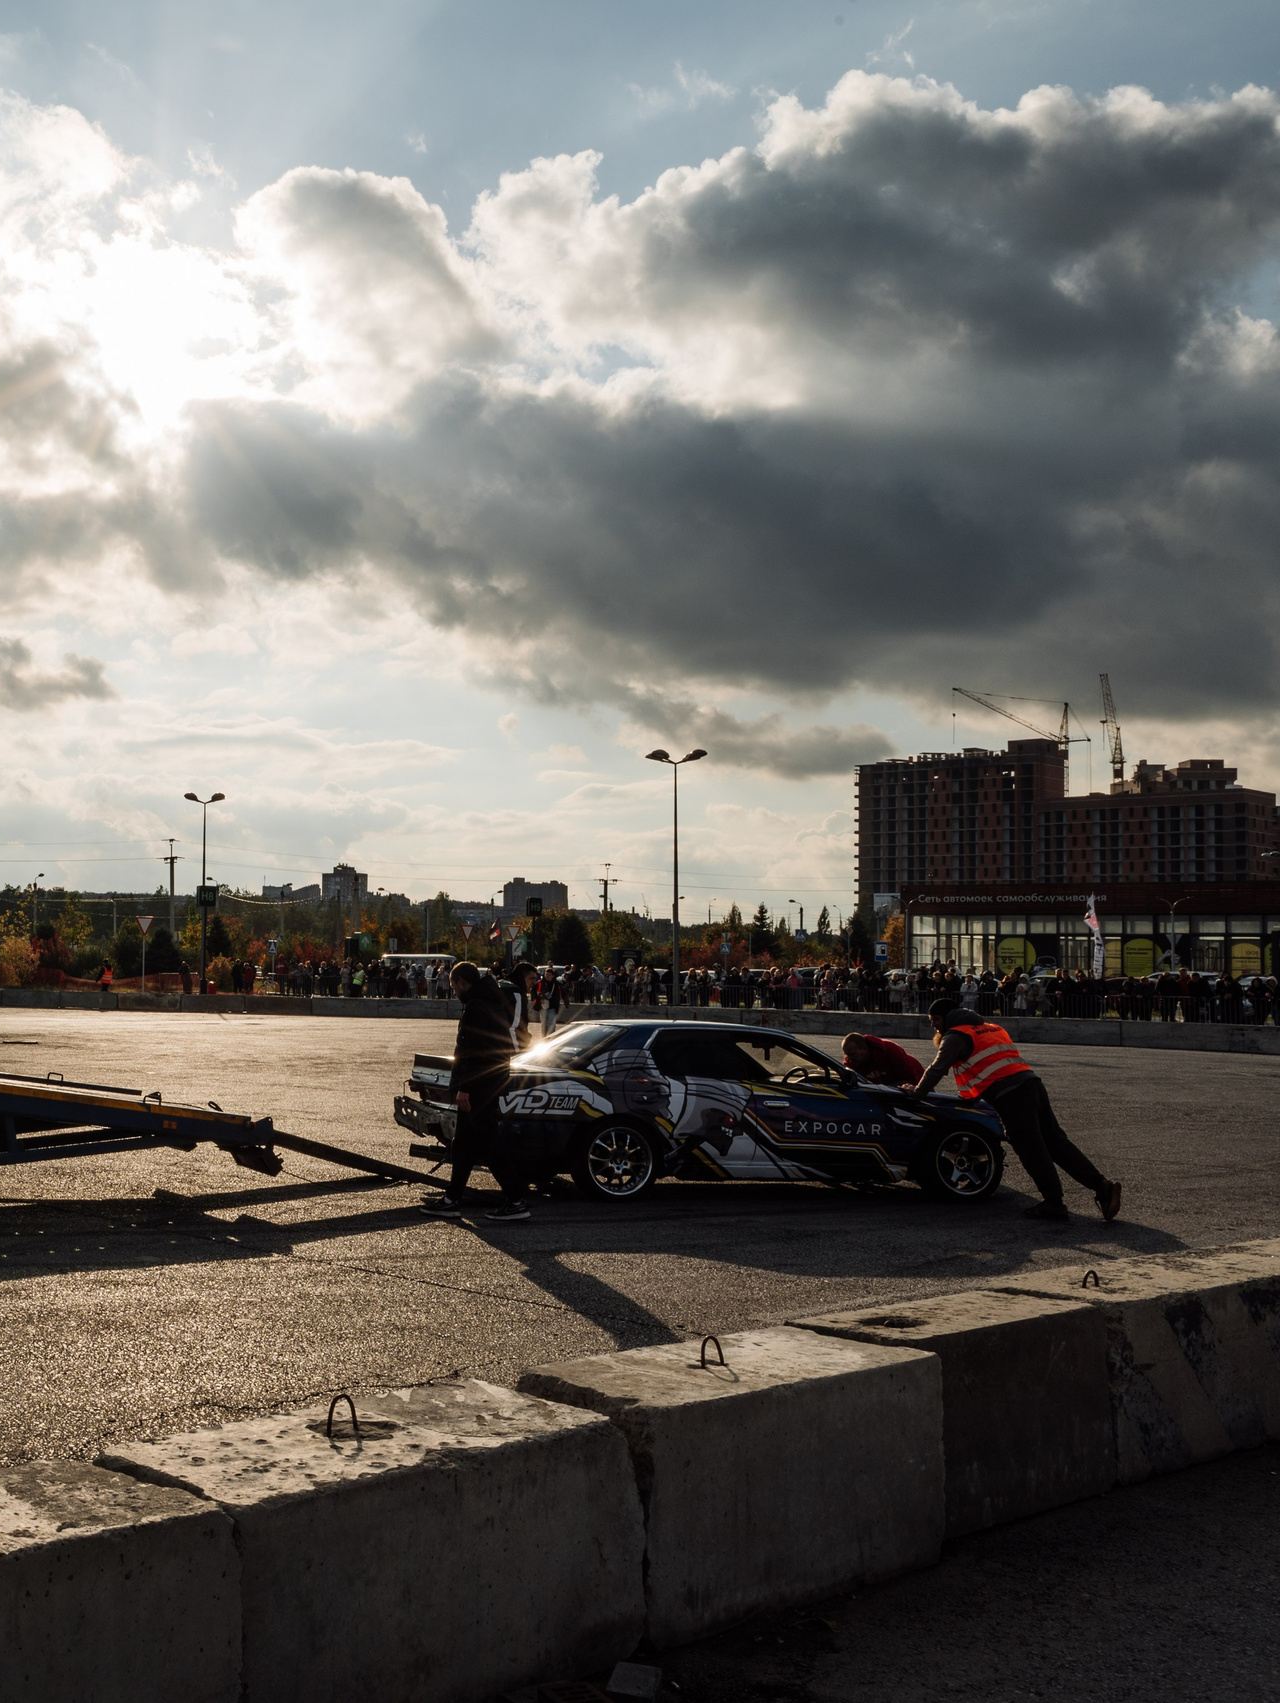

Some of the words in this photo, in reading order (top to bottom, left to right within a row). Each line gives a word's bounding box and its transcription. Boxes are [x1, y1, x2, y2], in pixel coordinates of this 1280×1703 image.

[201, 891, 215, 902] H8
[918, 894, 942, 904] Сеть
[943, 895, 994, 904] автомоек
[549, 1096, 580, 1109] TEAM
[784, 1120, 882, 1136] EXPOCAR
